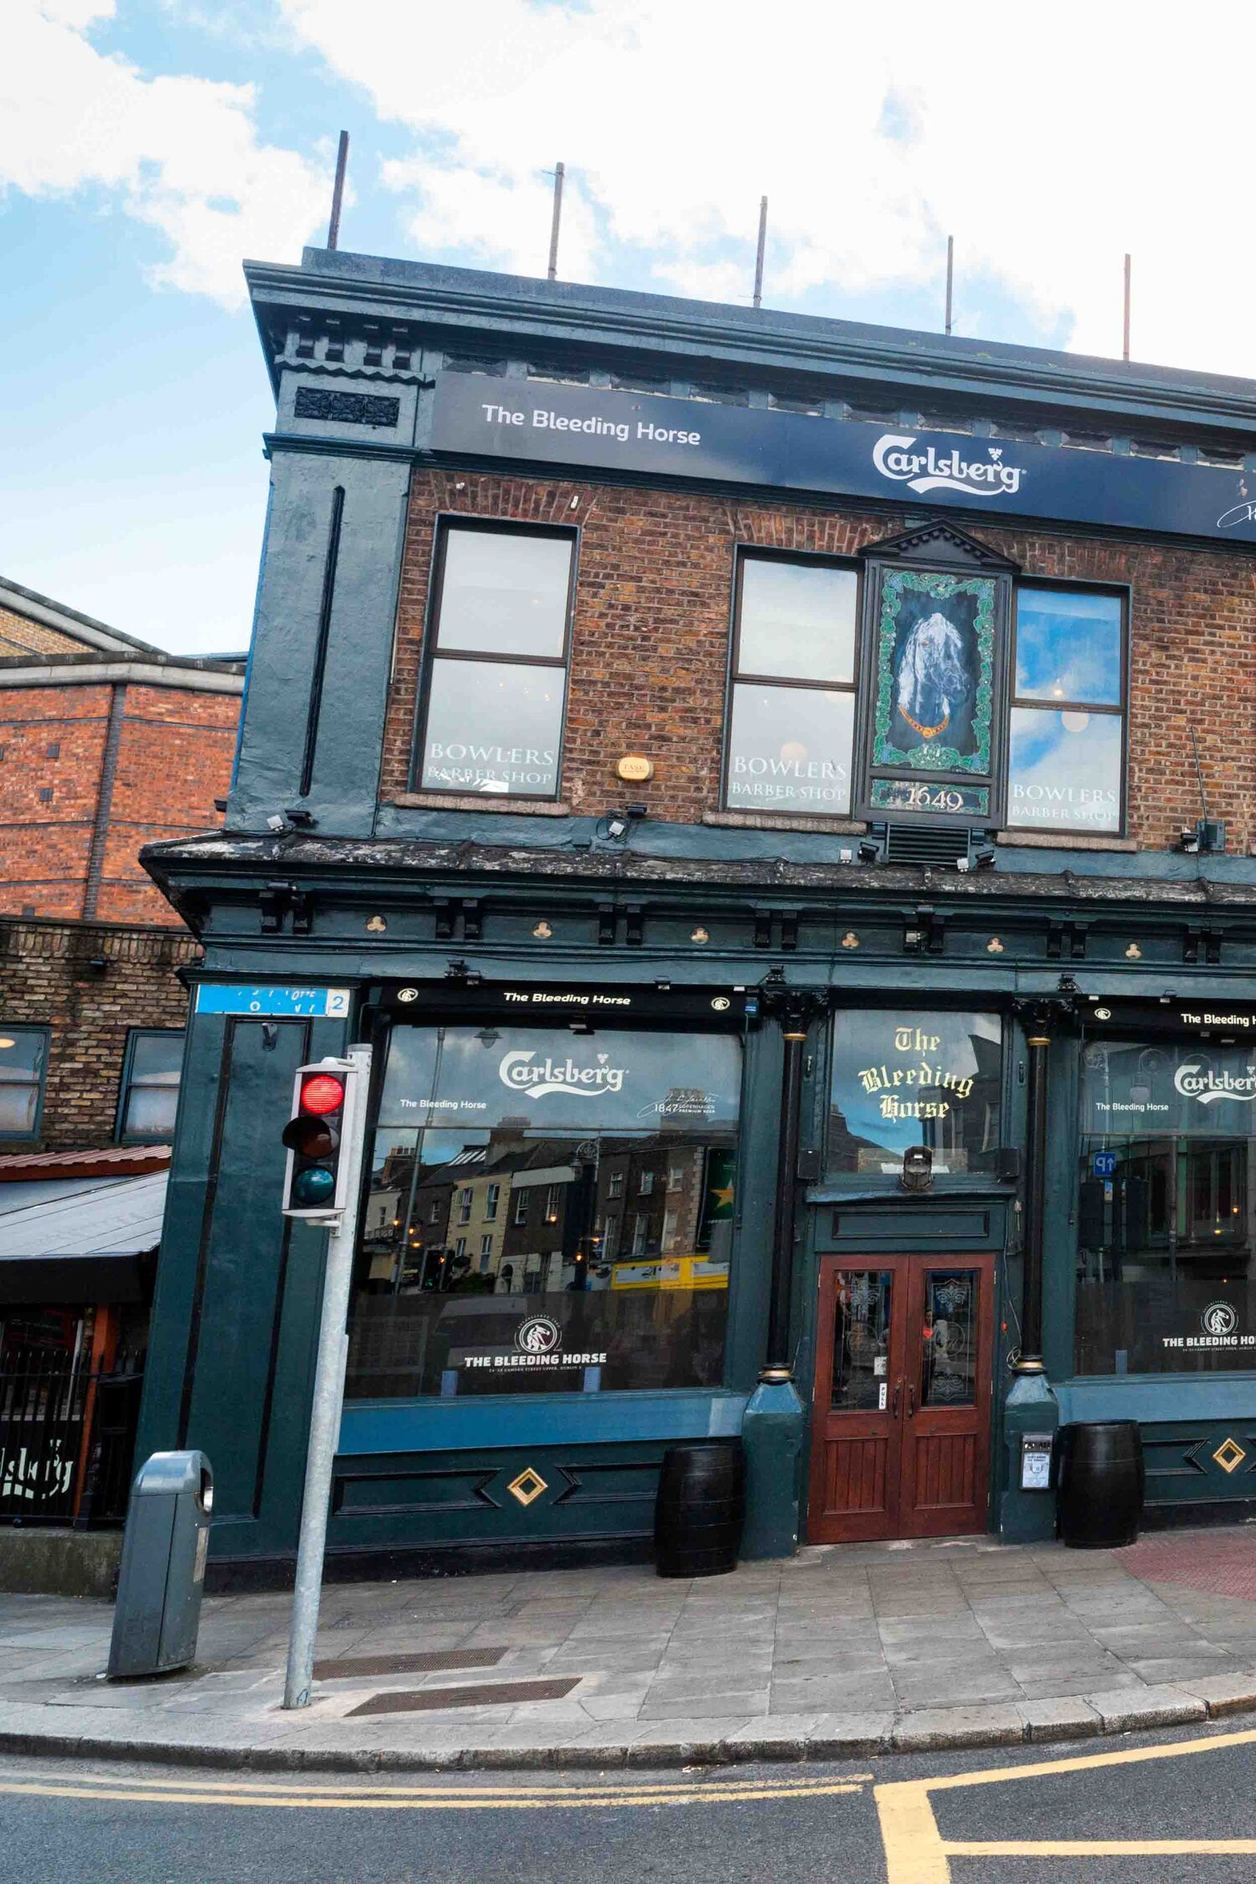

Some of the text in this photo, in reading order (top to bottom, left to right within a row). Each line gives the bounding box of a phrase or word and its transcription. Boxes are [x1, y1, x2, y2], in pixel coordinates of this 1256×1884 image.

[482, 404, 701, 445] The Bleeding Horse
[873, 434, 1021, 495] Carlsberg
[431, 743, 554, 766] BOWLERS
[428, 766, 552, 785] BARBER SHOP
[734, 756, 847, 780] BOWLERS
[732, 783, 847, 802] BARBER SHOP
[906, 786, 963, 811] 1649
[1013, 784, 1116, 805] BOWLERS
[1012, 805, 1118, 823] BARBER SHOP
[332, 996, 344, 1010] 2
[503, 992, 632, 1006] The Bleeding Horse
[1181, 1013, 1201, 1024] The
[1204, 1014, 1250, 1027] Bleeding
[895, 1027, 941, 1056] The
[499, 1051, 628, 1099] Carlsberg
[858, 1062, 974, 1098] Bleeding
[401, 1099, 487, 1110] The Bleeding Horse
[655, 1103, 679, 1113] 1847
[880, 1095, 950, 1124] Horse
[1096, 1102, 1169, 1112] The Bleeding Horse
[1162, 1338, 1184, 1348] THE
[1186, 1336, 1238, 1347] BLEEDING
[465, 1353, 607, 1367] THE BLEEDING HORSE
